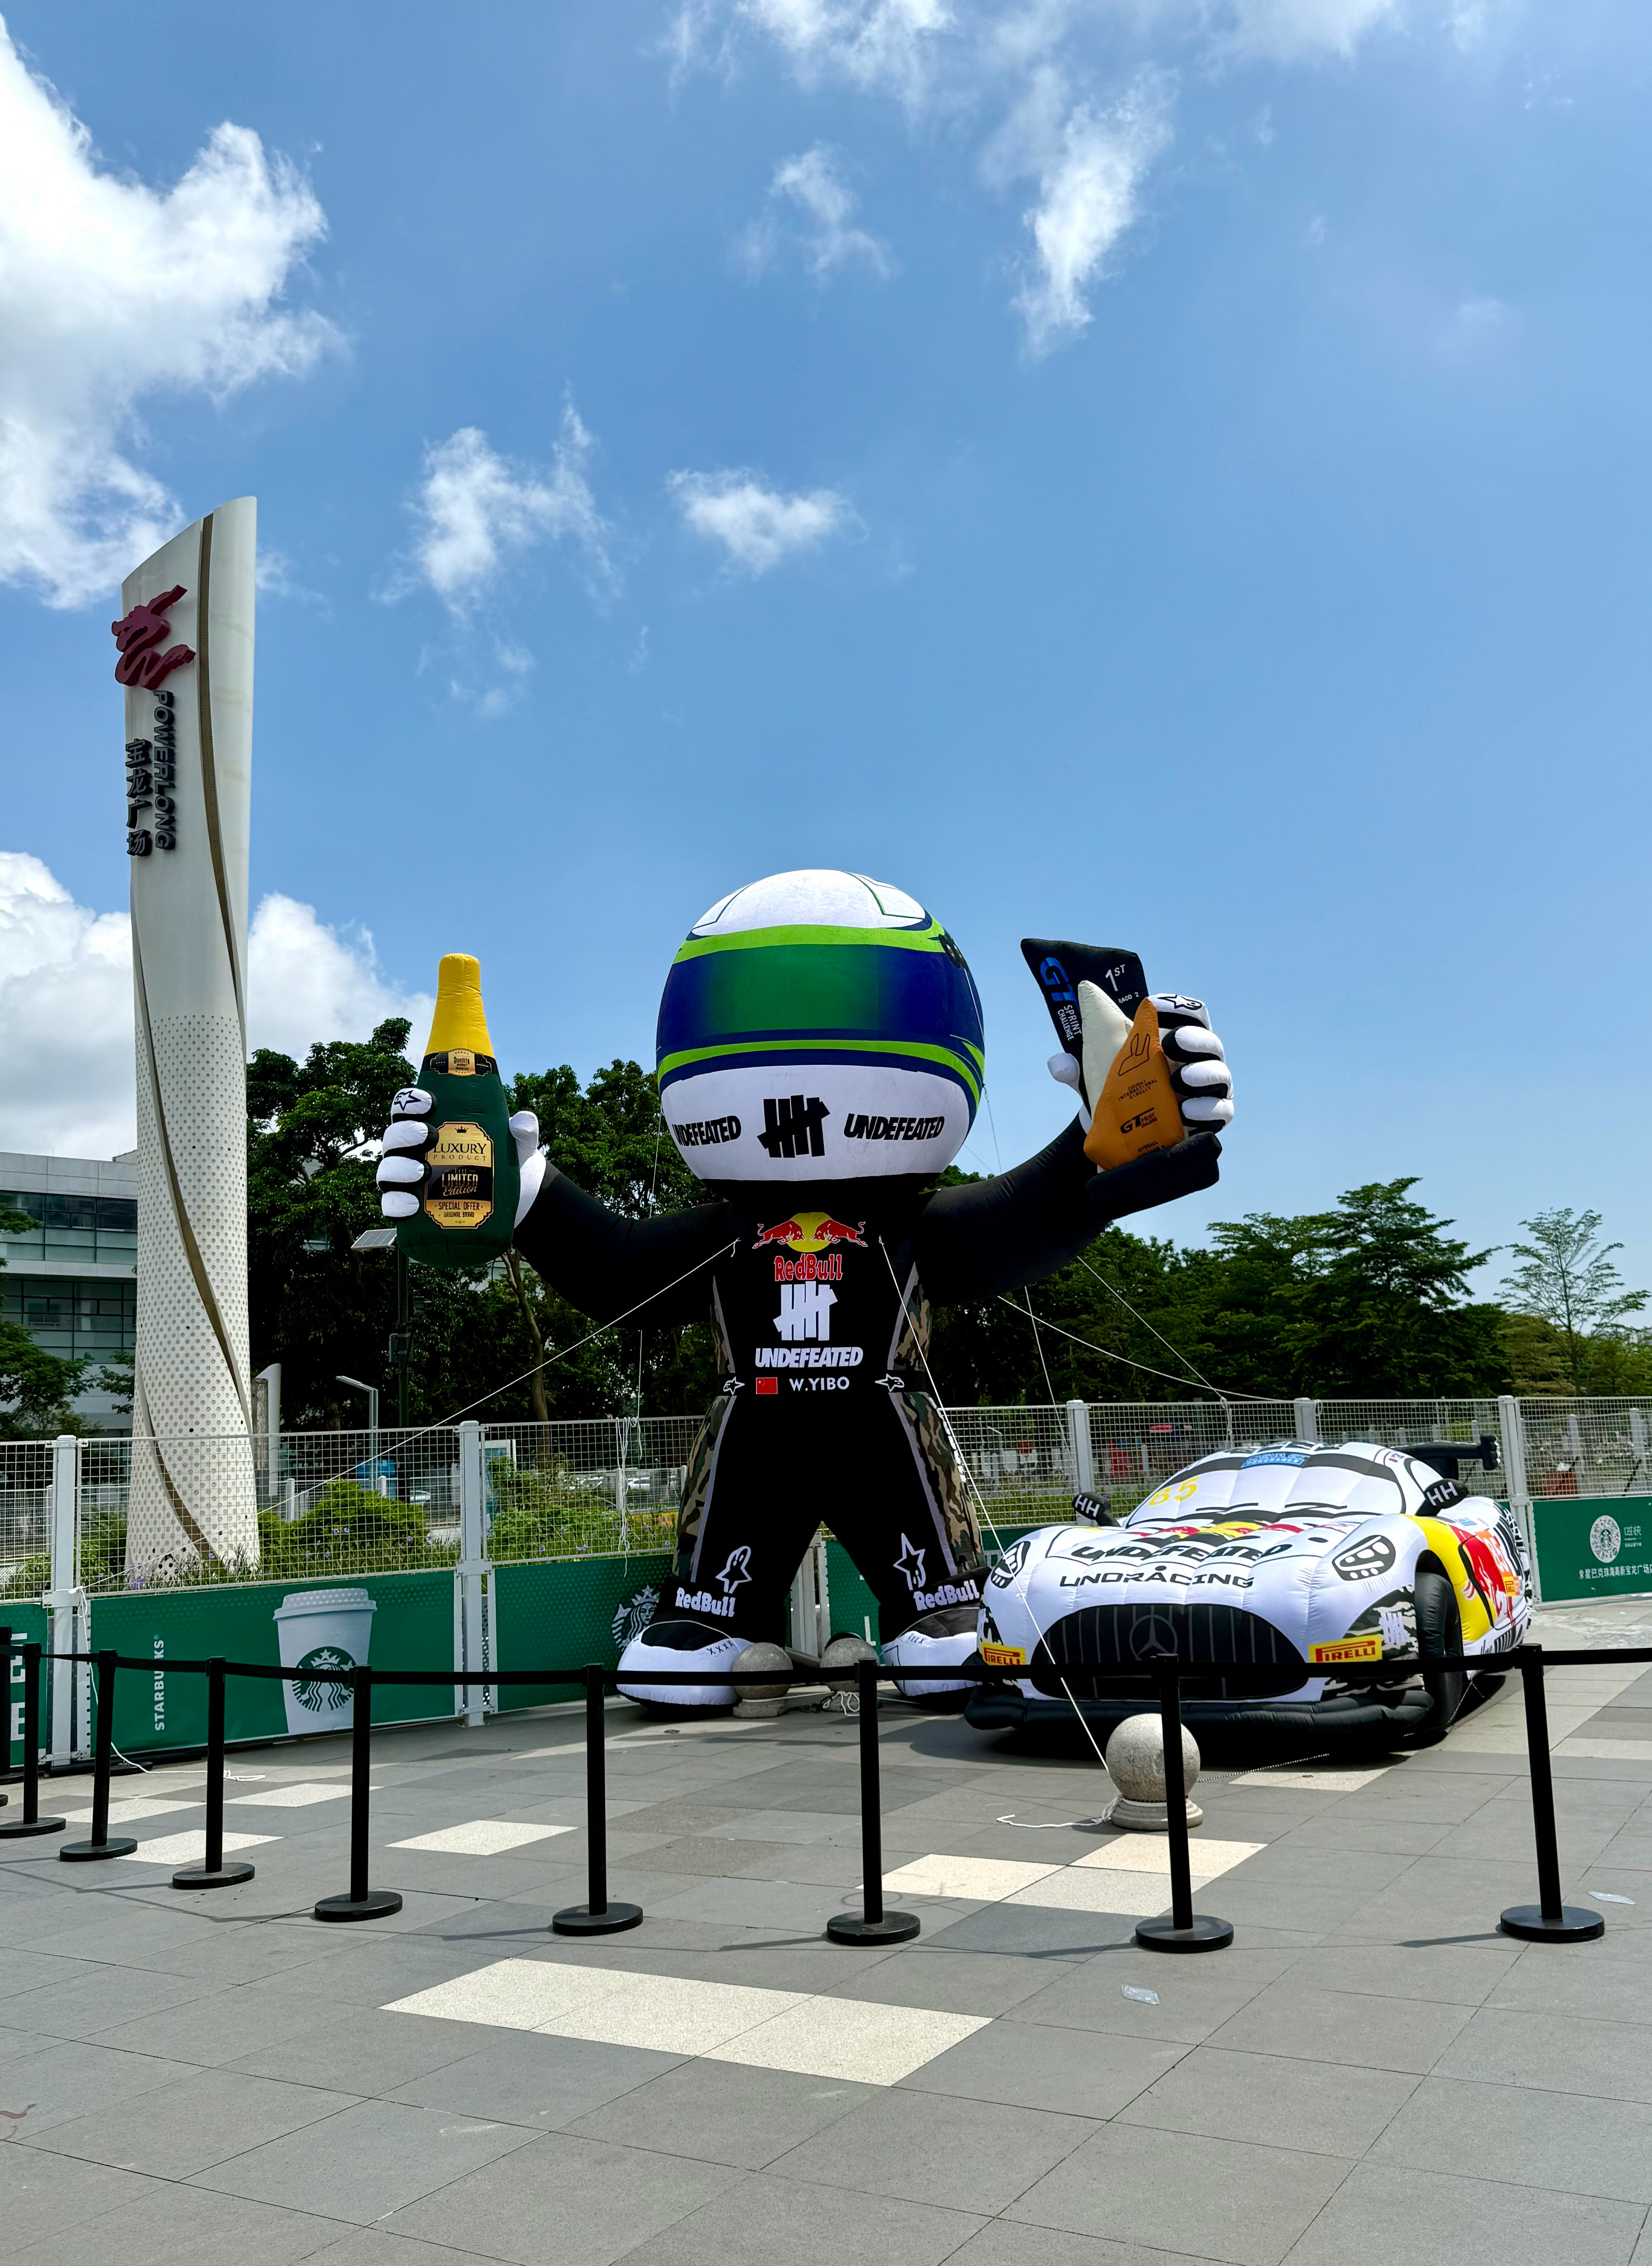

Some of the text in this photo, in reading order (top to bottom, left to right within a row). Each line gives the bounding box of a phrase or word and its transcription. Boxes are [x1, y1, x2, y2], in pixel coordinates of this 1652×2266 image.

[154, 690, 174, 850] POWERLONG
[126, 739, 151, 856] 宝龙广场
[1105, 964, 1125, 991] 1ST
[1057, 1009, 1074, 1041] CHALLENGE
[1064, 1005, 1082, 1035] SPRINT
[1118, 1079, 1158, 1101] INTERNATIONAL
[1128, 1080, 1146, 1091] ZHUHAI
[1129, 1086, 1151, 1099] CIRCUIT
[844, 1113, 944, 1140] UNDEFEATED
[1120, 1107, 1154, 1134] GT
[433, 1143, 487, 1154] LUXURY
[1138, 1141, 1158, 1152] OVERALL
[442, 1174, 478, 1187] LIMITED
[443, 1184, 477, 1196] Edition
[439, 1202, 479, 1210] SPECIAL OFFER
[774, 1253, 843, 1281] RedBull
[755, 1347, 864, 1368] UNDEFEATED
[789, 1376, 850, 1391] W.YIBO
[1148, 1476, 1200, 1506] 85
[1426, 1481, 1458, 1506] HH
[1075, 1494, 1100, 1517] HH
[1071, 1544, 1293, 1562] UNDEFEATED
[675, 1587, 736, 1617] RedBull
[913, 1579, 980, 1611] RedBull
[984, 1647, 1020, 1665] PIRELLI
[1315, 1641, 1375, 1662] PIRELLI
[154, 1640, 165, 1731] STARBUKS
